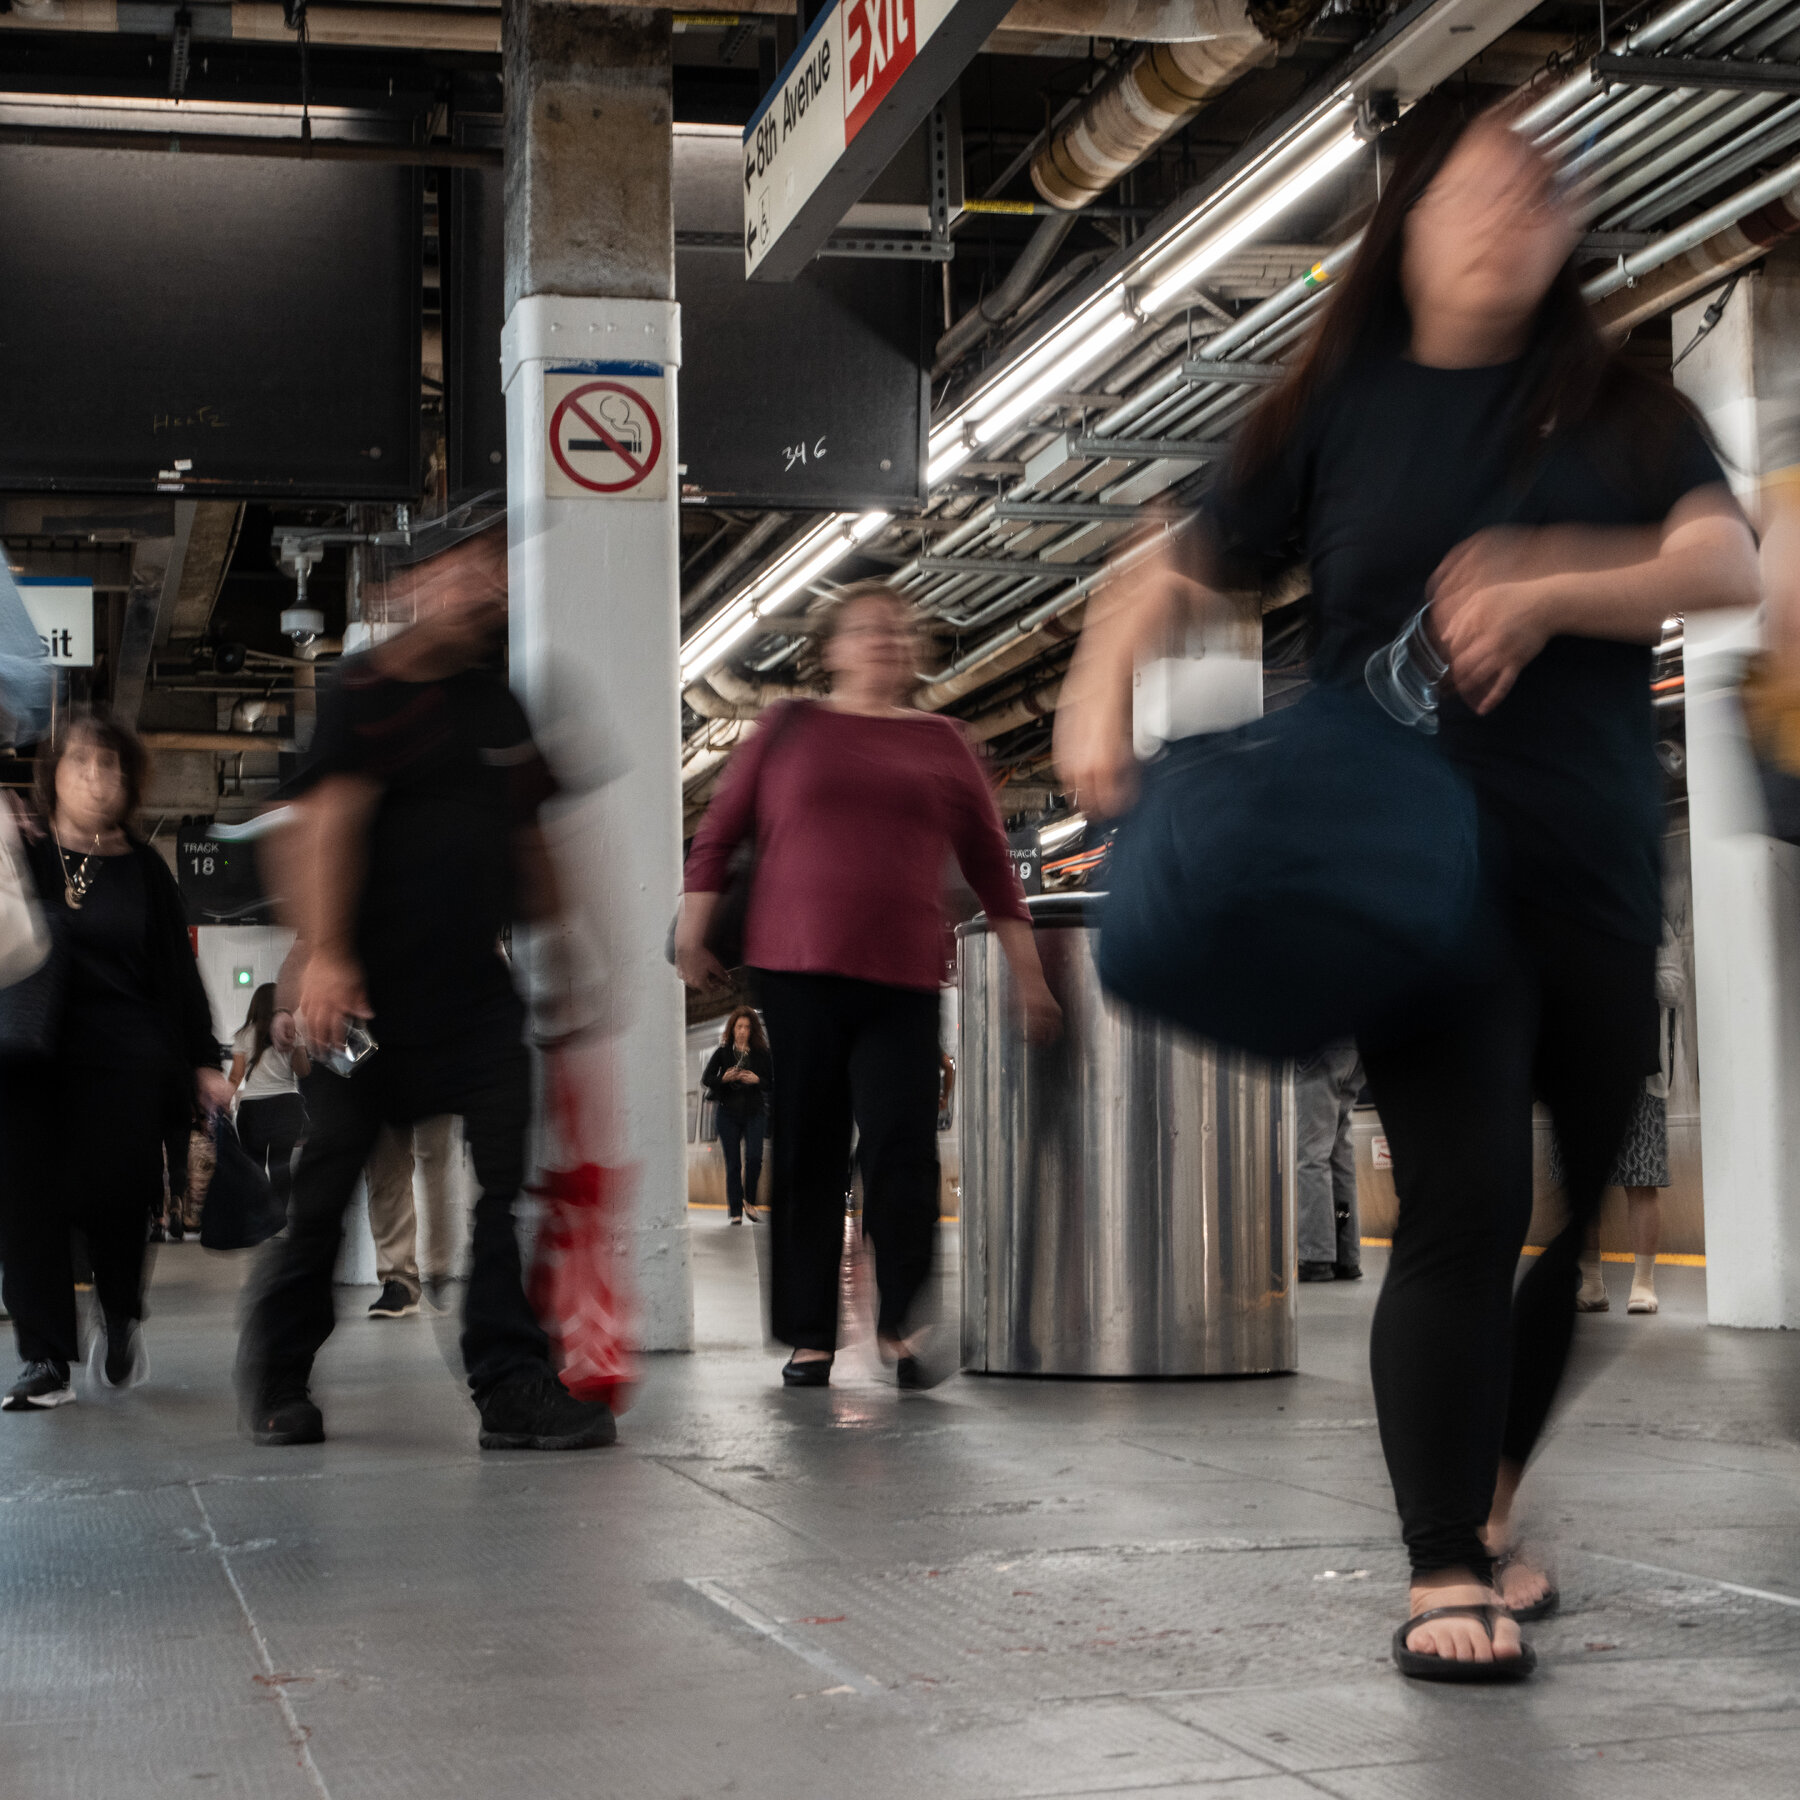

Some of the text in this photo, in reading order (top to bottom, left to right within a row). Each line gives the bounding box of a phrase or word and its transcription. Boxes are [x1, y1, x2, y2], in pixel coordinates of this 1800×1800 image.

[756, 38, 831, 178] 8th Avenue
[781, 435, 828, 472] 346
[183, 842, 220, 854] TRACK
[1005, 848, 1038, 859] TRACK
[190, 856, 216, 876] 18
[1009, 861, 1032, 880] 19
